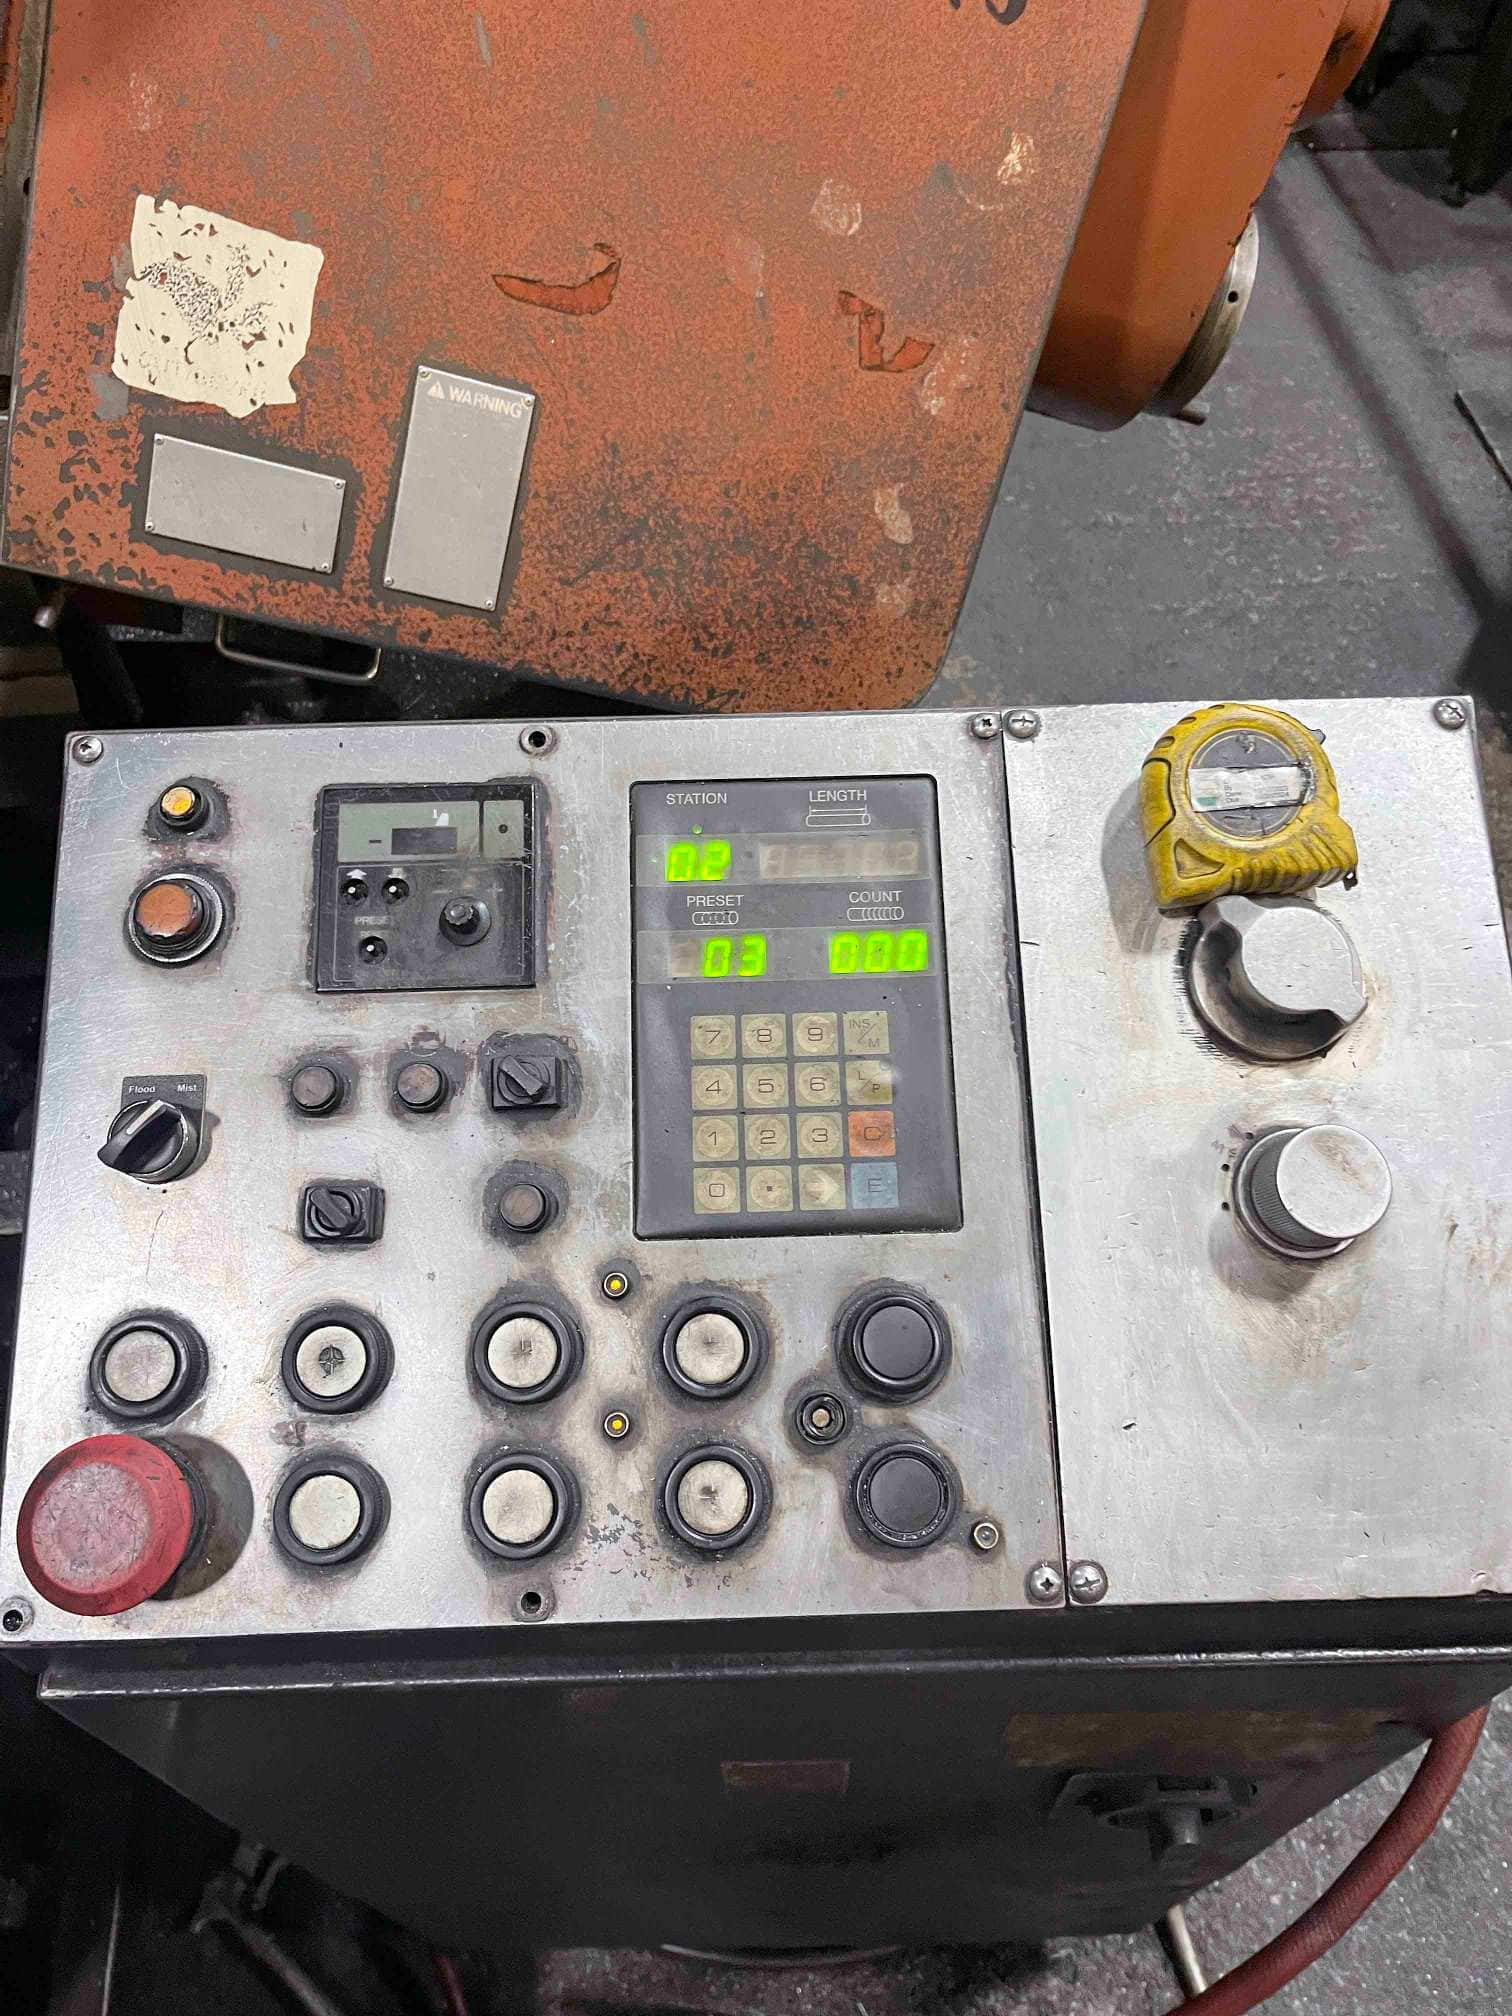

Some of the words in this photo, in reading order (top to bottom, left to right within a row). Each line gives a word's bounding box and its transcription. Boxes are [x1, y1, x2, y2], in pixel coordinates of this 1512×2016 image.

[448, 385, 521, 418] WARNING
[665, 792, 727, 806] STATION
[808, 789, 868, 803] LENGTH
[667, 840, 731, 881] 02
[686, 894, 744, 908] PRESET
[848, 890, 903, 903] COUNT
[704, 935, 767, 977] 03
[829, 929, 929, 975] 000
[704, 1030, 721, 1044] 7
[756, 1028, 773, 1043] 8
[807, 1027, 824, 1042] 9
[128, 1085, 156, 1094] Flood
[177, 1083, 197, 1092] Mist
[705, 1080, 722, 1095] 4
[757, 1078, 775, 1094] 5
[809, 1077, 827, 1092] 6
[707, 1131, 718, 1146] 1
[759, 1130, 777, 1145] 2
[811, 1128, 829, 1143] 3
[863, 1127, 882, 1141] C
[708, 1183, 725, 1198] 0
[867, 1178, 883, 1193] E
